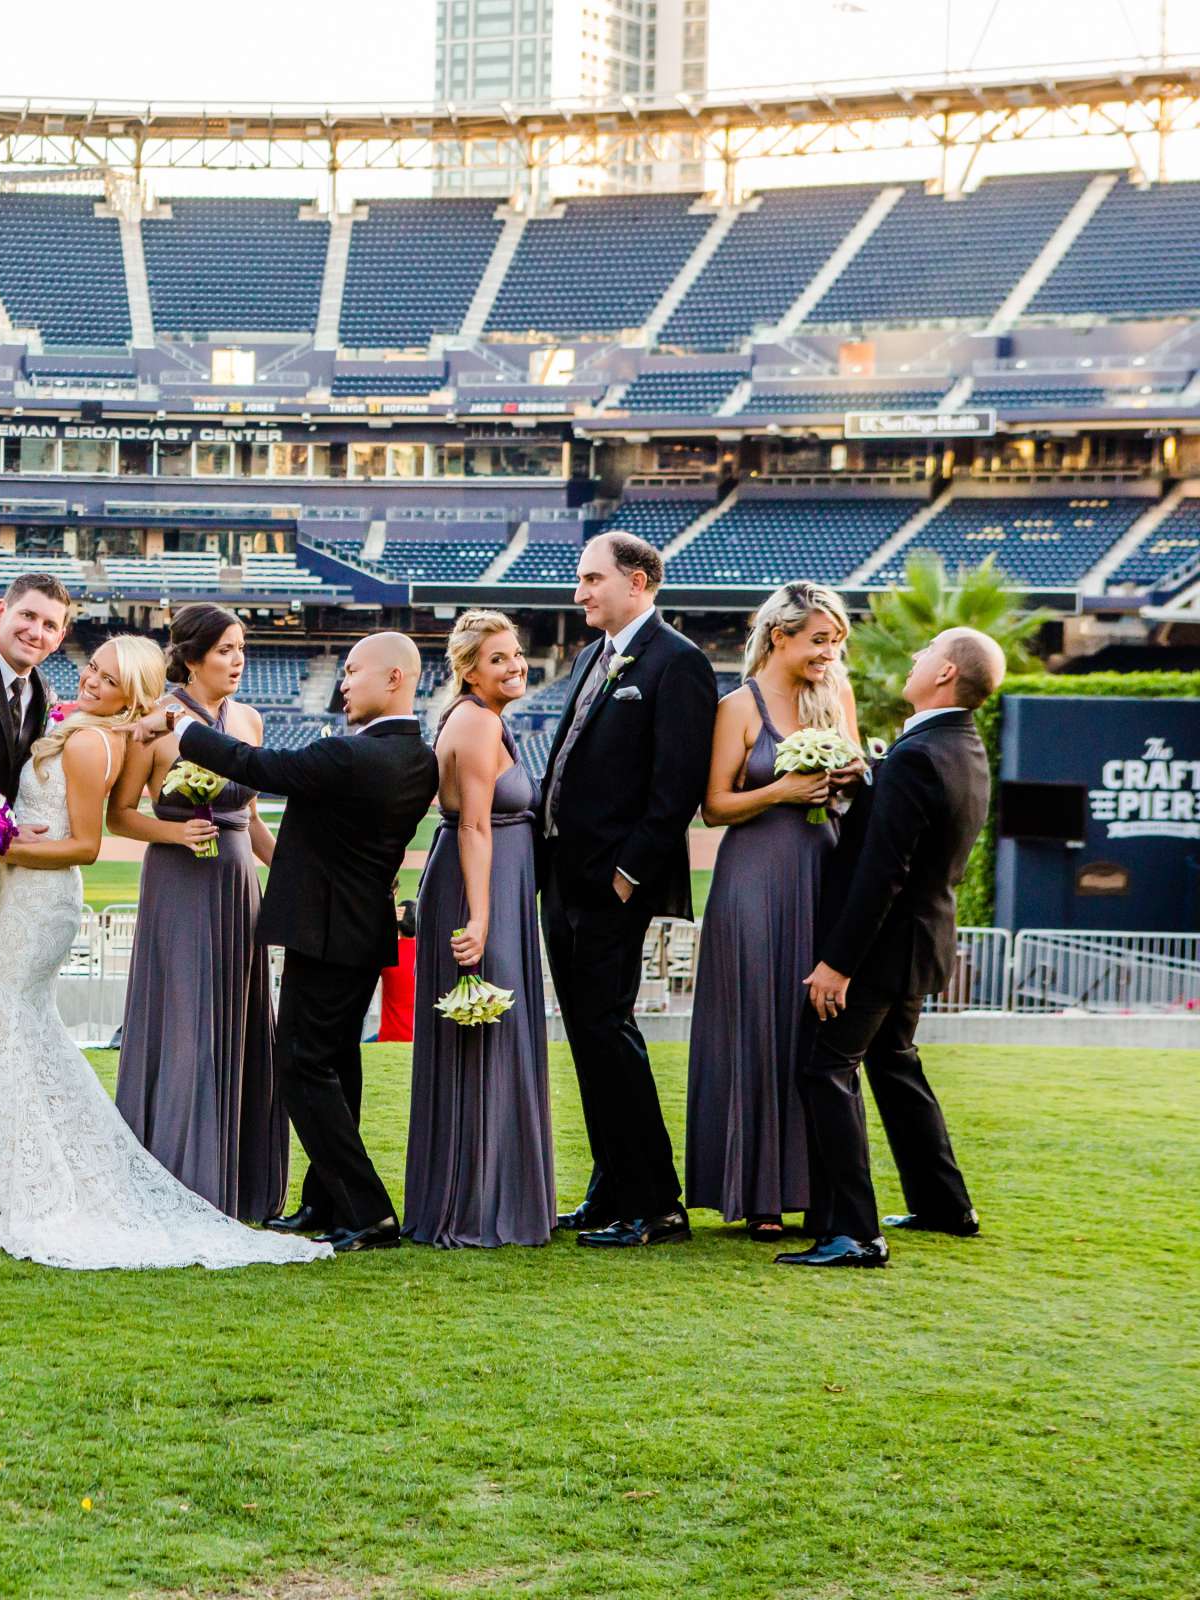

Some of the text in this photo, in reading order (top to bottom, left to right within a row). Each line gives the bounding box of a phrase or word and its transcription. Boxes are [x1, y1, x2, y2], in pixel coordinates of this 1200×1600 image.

[64, 426, 192, 440] BROADCAST
[200, 428, 283, 442] CENTER
[1141, 737, 1174, 760] The
[1118, 790, 1195, 820] PIER
